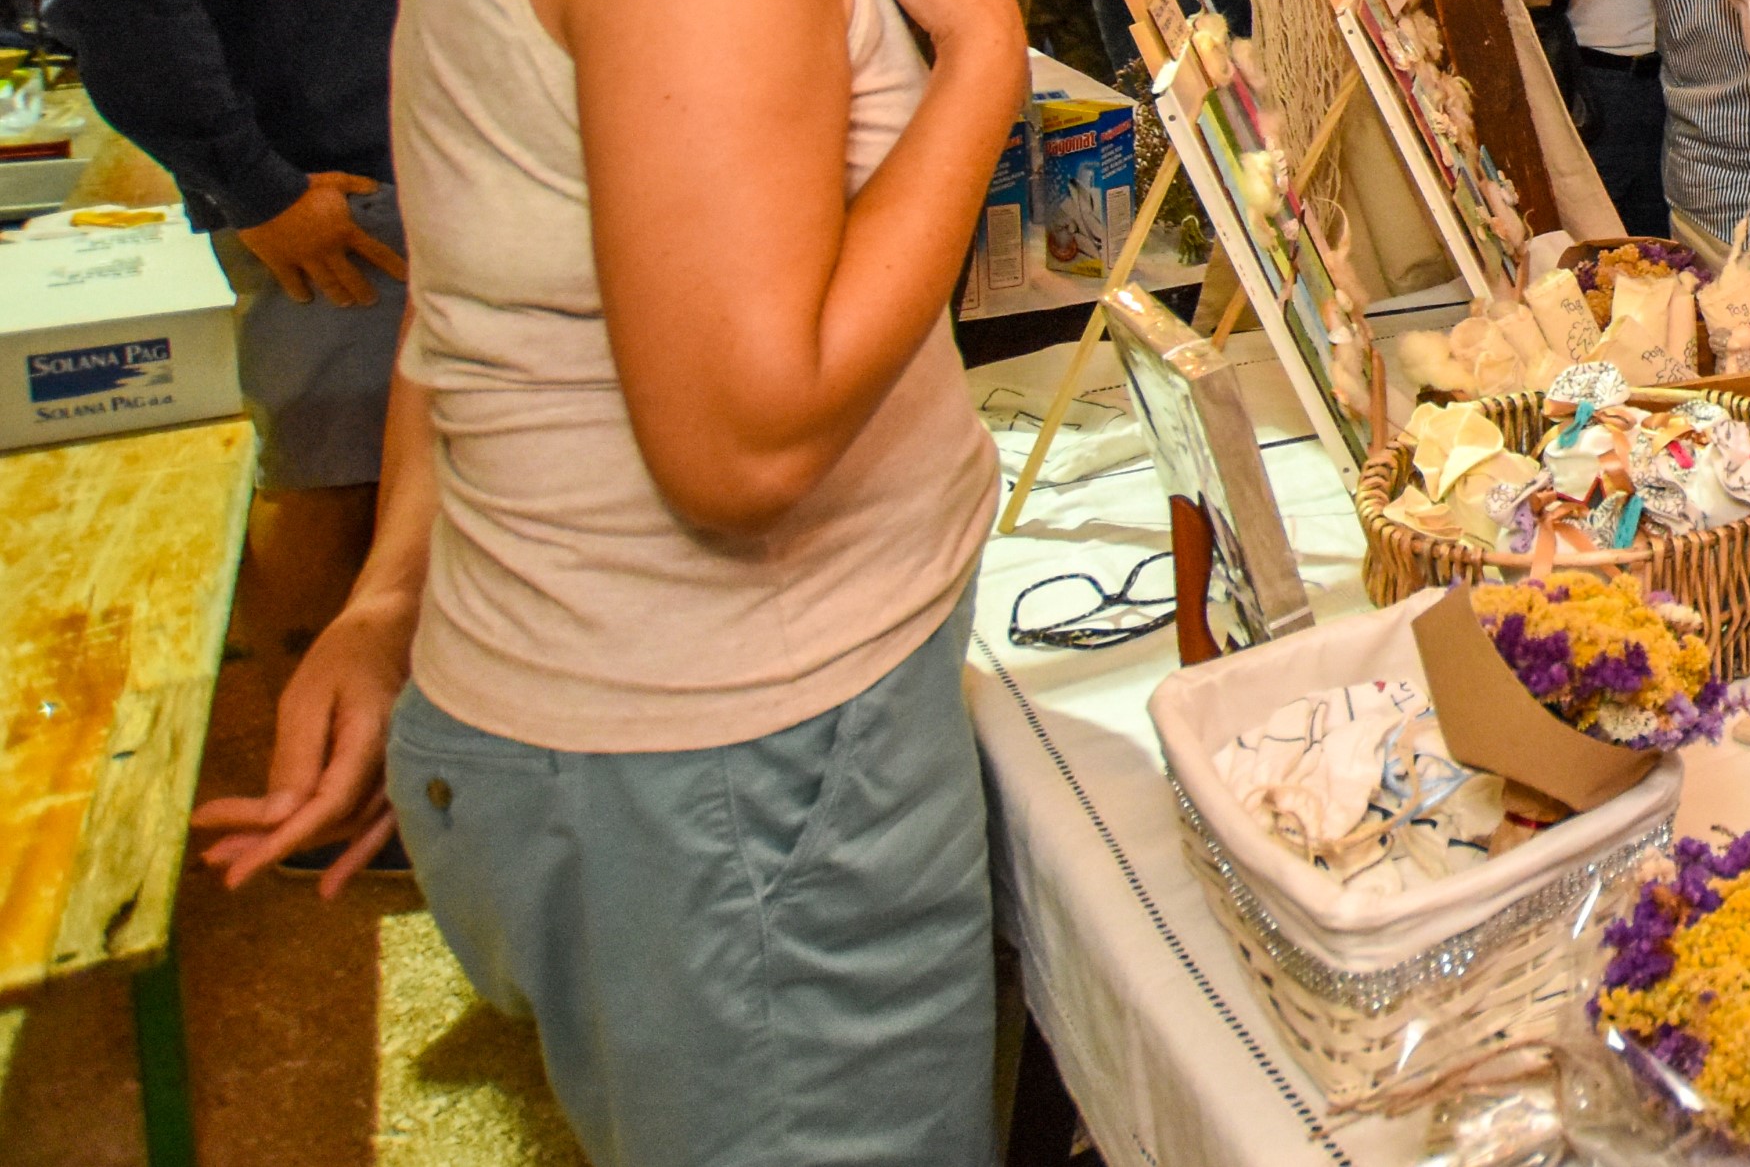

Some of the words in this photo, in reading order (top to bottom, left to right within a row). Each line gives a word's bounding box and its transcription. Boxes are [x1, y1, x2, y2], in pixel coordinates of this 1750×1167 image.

[1560, 298, 1584, 316] Pag
[1725, 303, 1750, 318] Pag
[1641, 345, 1666, 364] Pag
